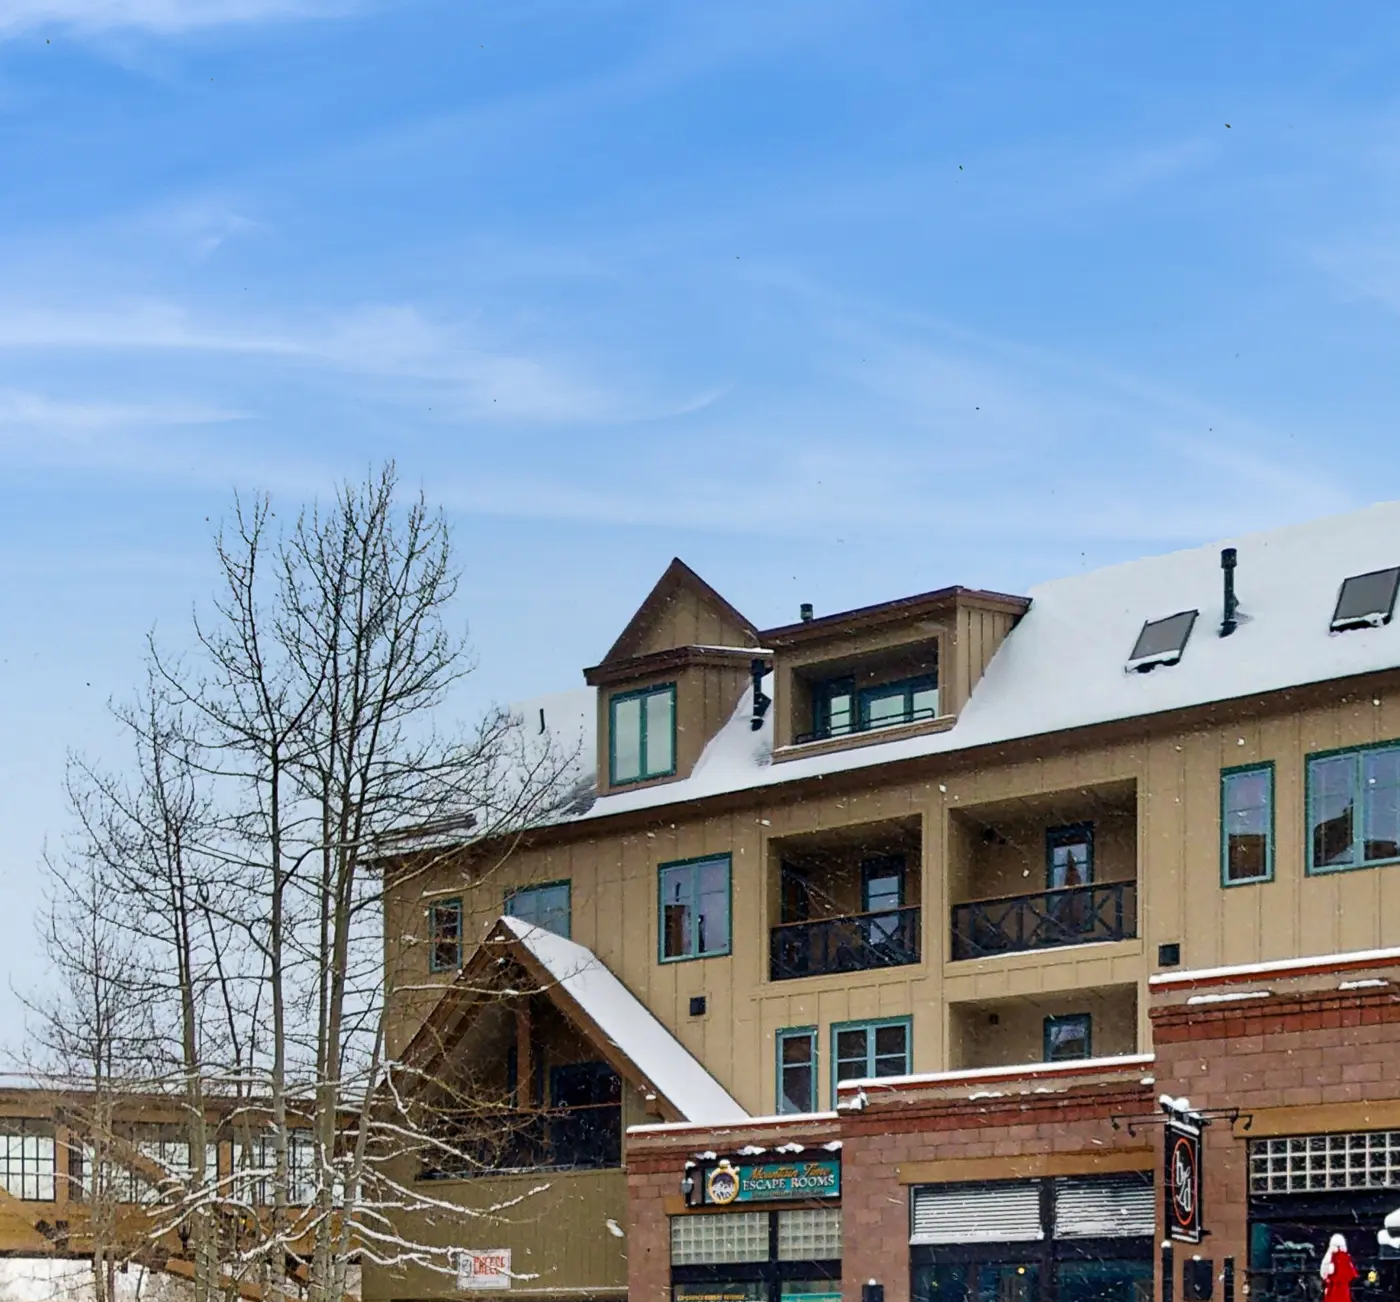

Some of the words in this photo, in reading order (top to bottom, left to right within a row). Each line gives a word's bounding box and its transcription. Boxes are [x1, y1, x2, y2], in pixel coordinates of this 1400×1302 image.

[751, 1167, 798, 1180] Mountain
[803, 1162, 831, 1177] Time
[743, 1178, 786, 1191] ESCAPE
[791, 1174, 835, 1188] ROOMS
